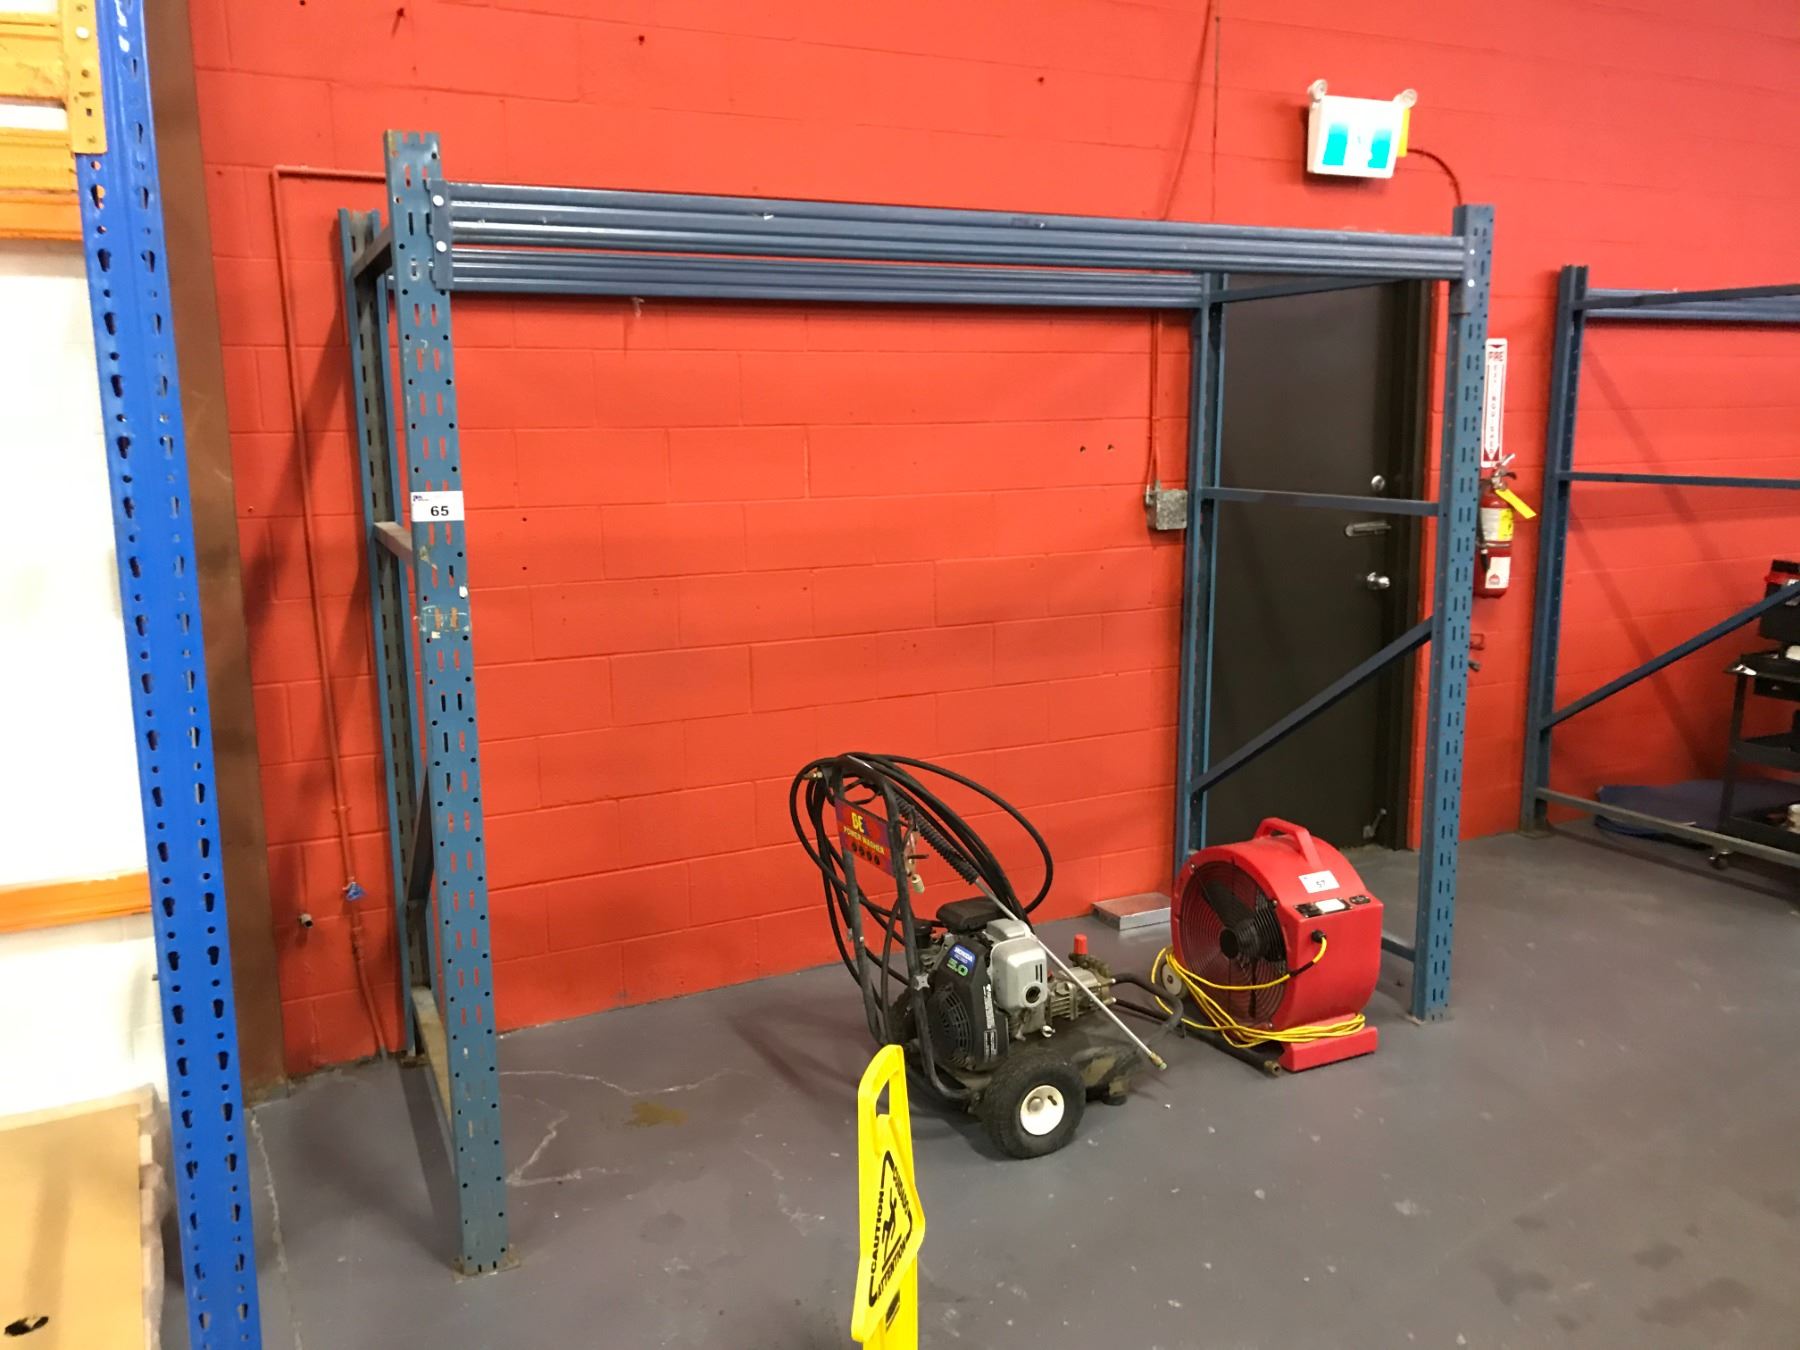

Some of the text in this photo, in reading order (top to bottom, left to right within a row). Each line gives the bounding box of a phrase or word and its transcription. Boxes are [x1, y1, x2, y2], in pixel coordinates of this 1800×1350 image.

[430, 505, 449, 517] 65
[953, 946, 973, 962] HONDA
[871, 1190, 884, 1275] CAUTION
